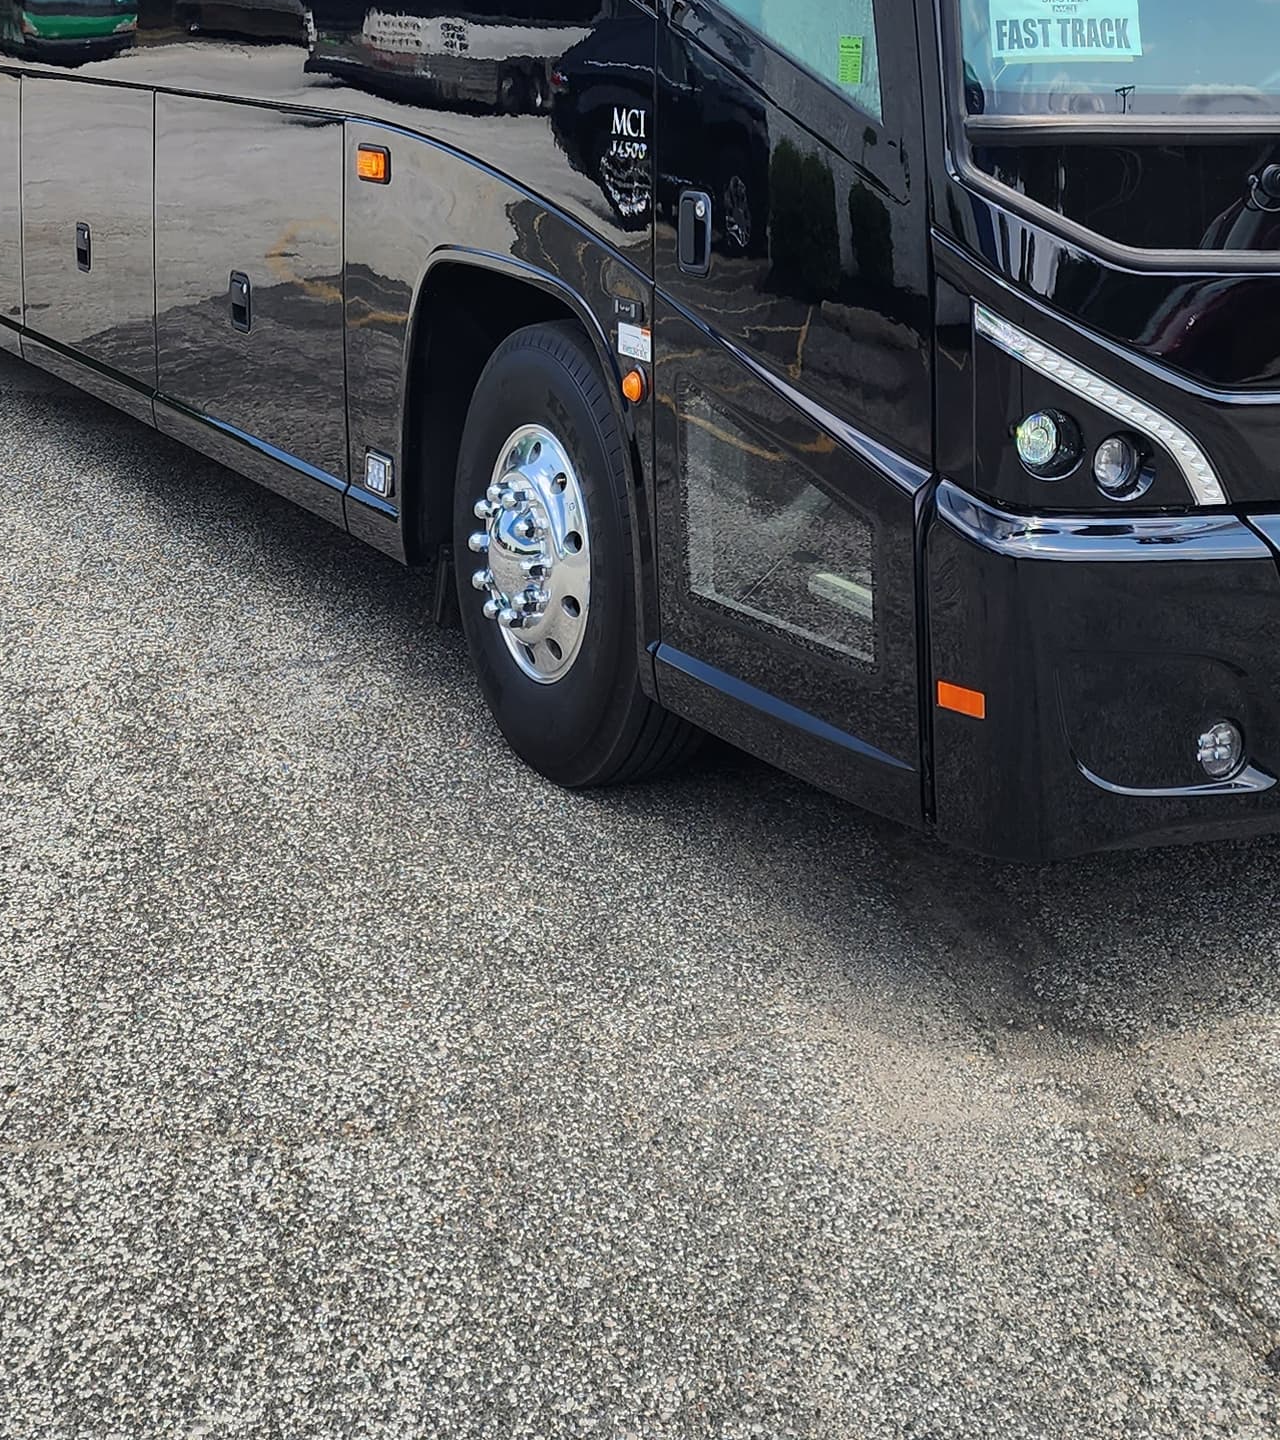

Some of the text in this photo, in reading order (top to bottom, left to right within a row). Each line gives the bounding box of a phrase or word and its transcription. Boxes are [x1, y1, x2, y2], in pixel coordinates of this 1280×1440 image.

[996, 18, 1131, 51] FAST TRACK
[611, 107, 646, 138] MCI
[610, 140, 647, 159] J4500
